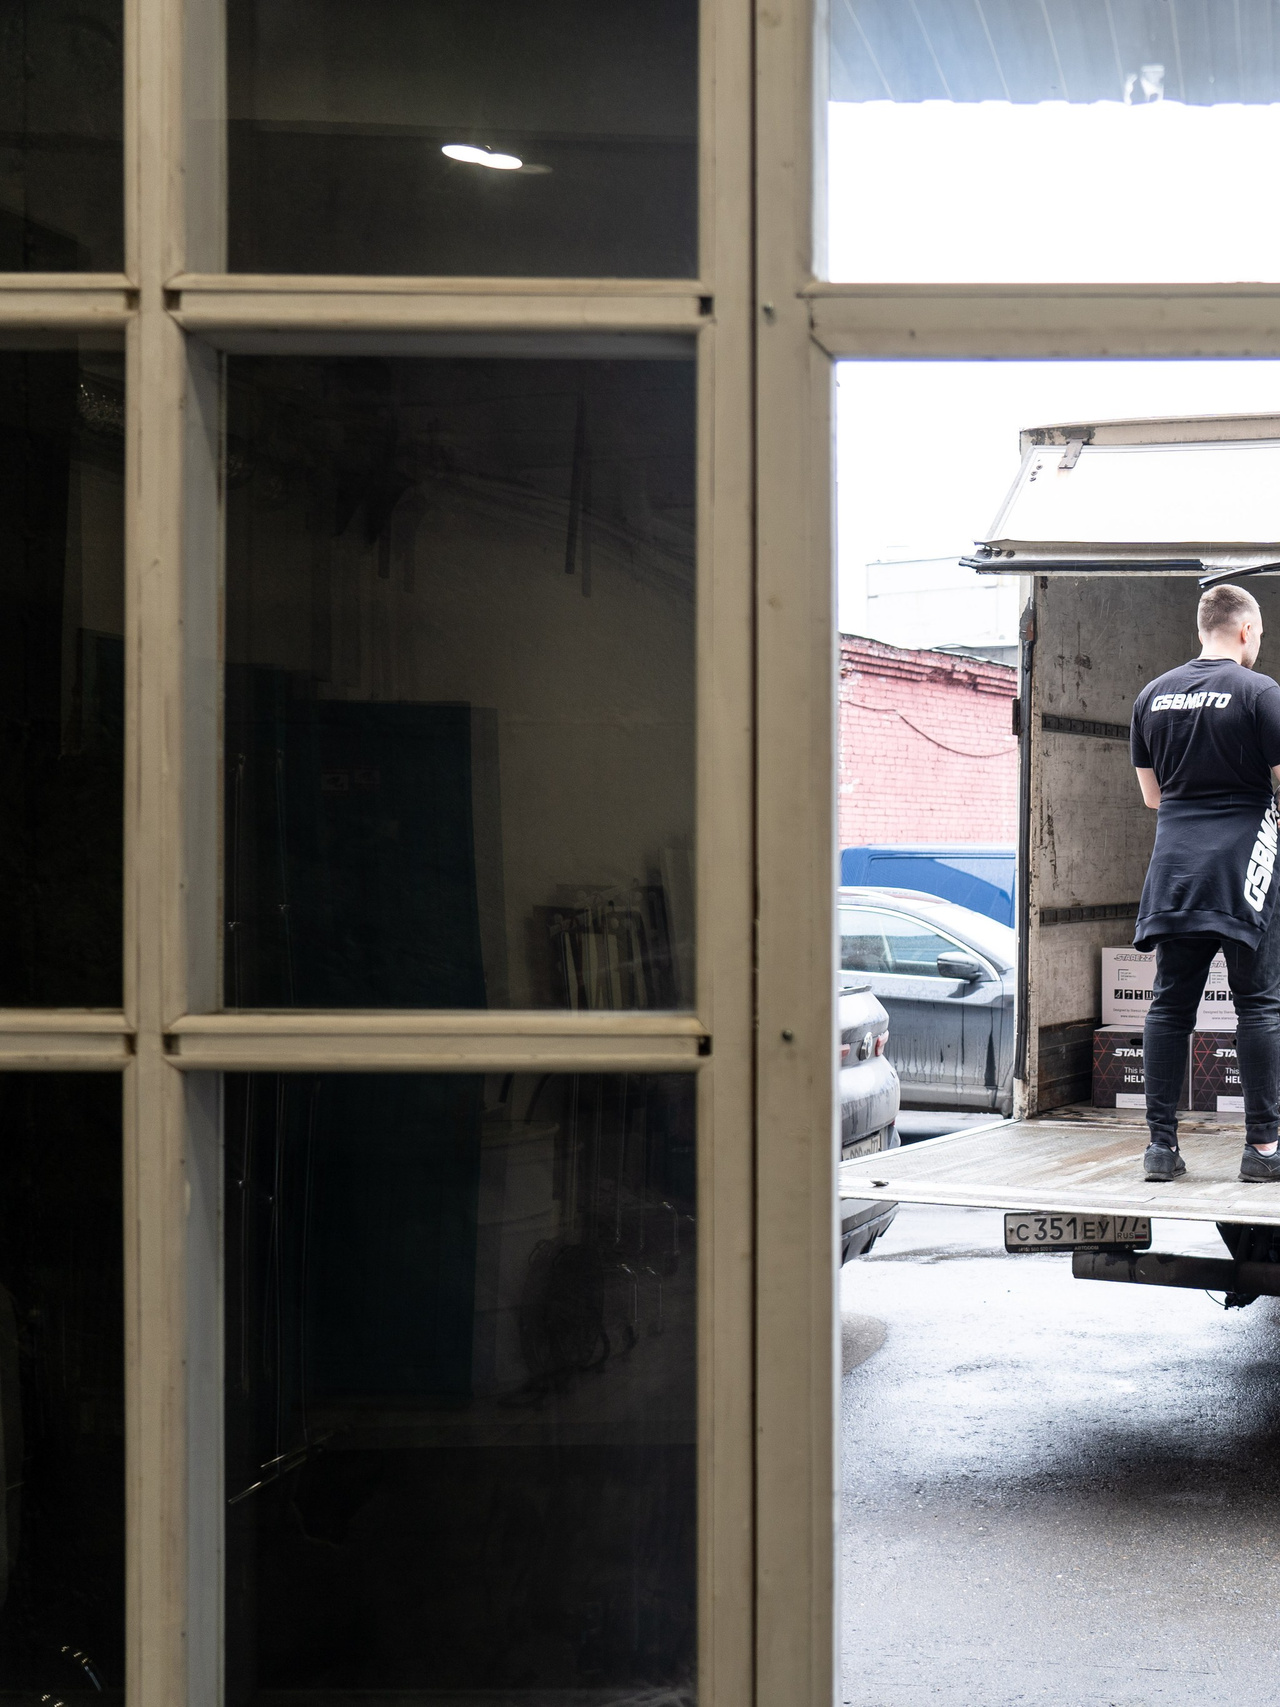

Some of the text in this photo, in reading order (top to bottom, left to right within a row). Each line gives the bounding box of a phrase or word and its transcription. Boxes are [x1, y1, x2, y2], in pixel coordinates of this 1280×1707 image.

[1151, 691, 1232, 713] GSBMOTO
[1243, 796, 1279, 912] GSBM
[1112, 1048, 1144, 1058] STAR
[1124, 1066, 1138, 1074] This
[1225, 1075, 1241, 1084] HEL
[1116, 1232, 1135, 1240] RUS
